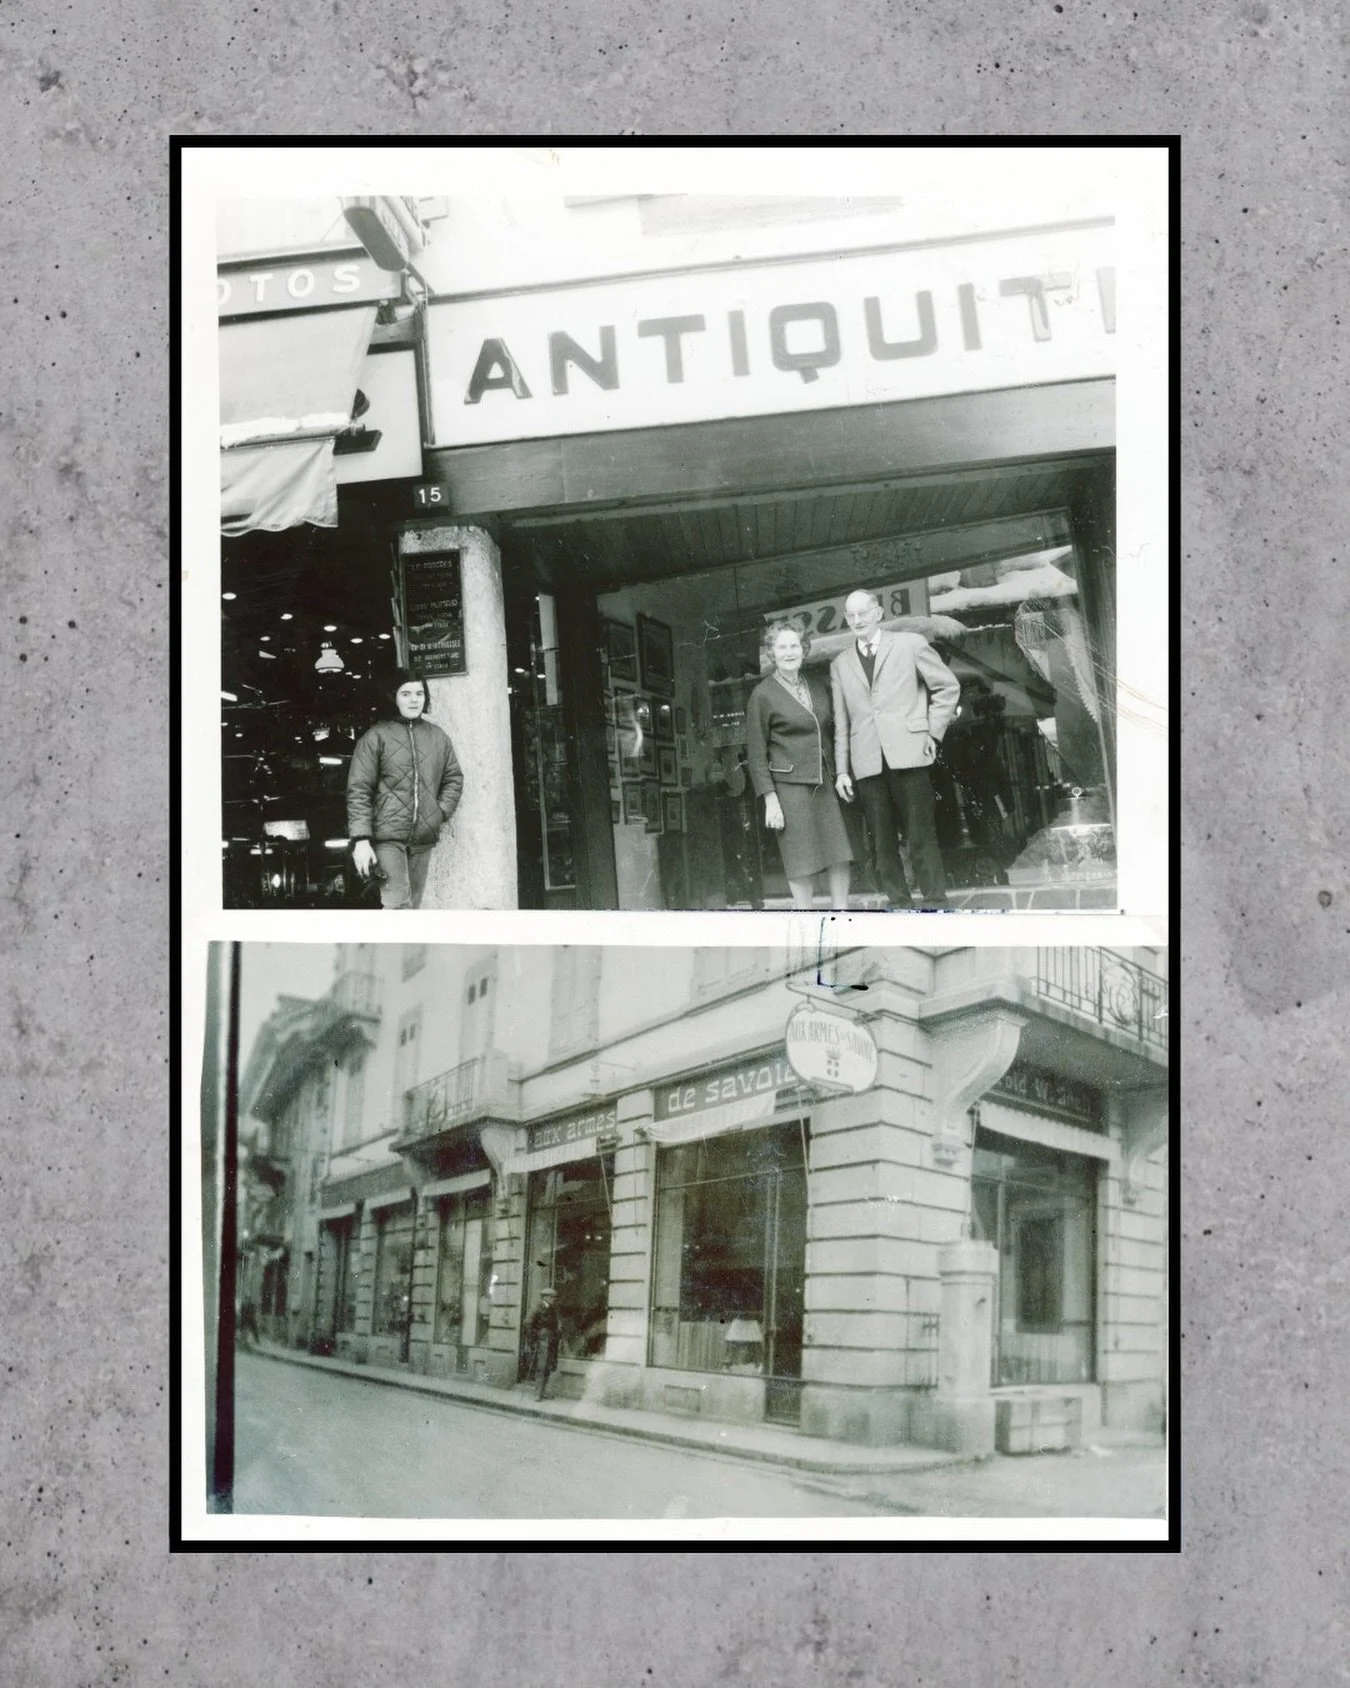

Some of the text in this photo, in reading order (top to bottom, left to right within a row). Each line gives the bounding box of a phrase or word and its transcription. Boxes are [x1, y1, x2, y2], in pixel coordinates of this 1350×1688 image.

[419, 486, 442, 504] 15
[808, 1020, 840, 1046] ARMES
[667, 1086, 696, 1113] de
[534, 1110, 616, 1149] aux armes
